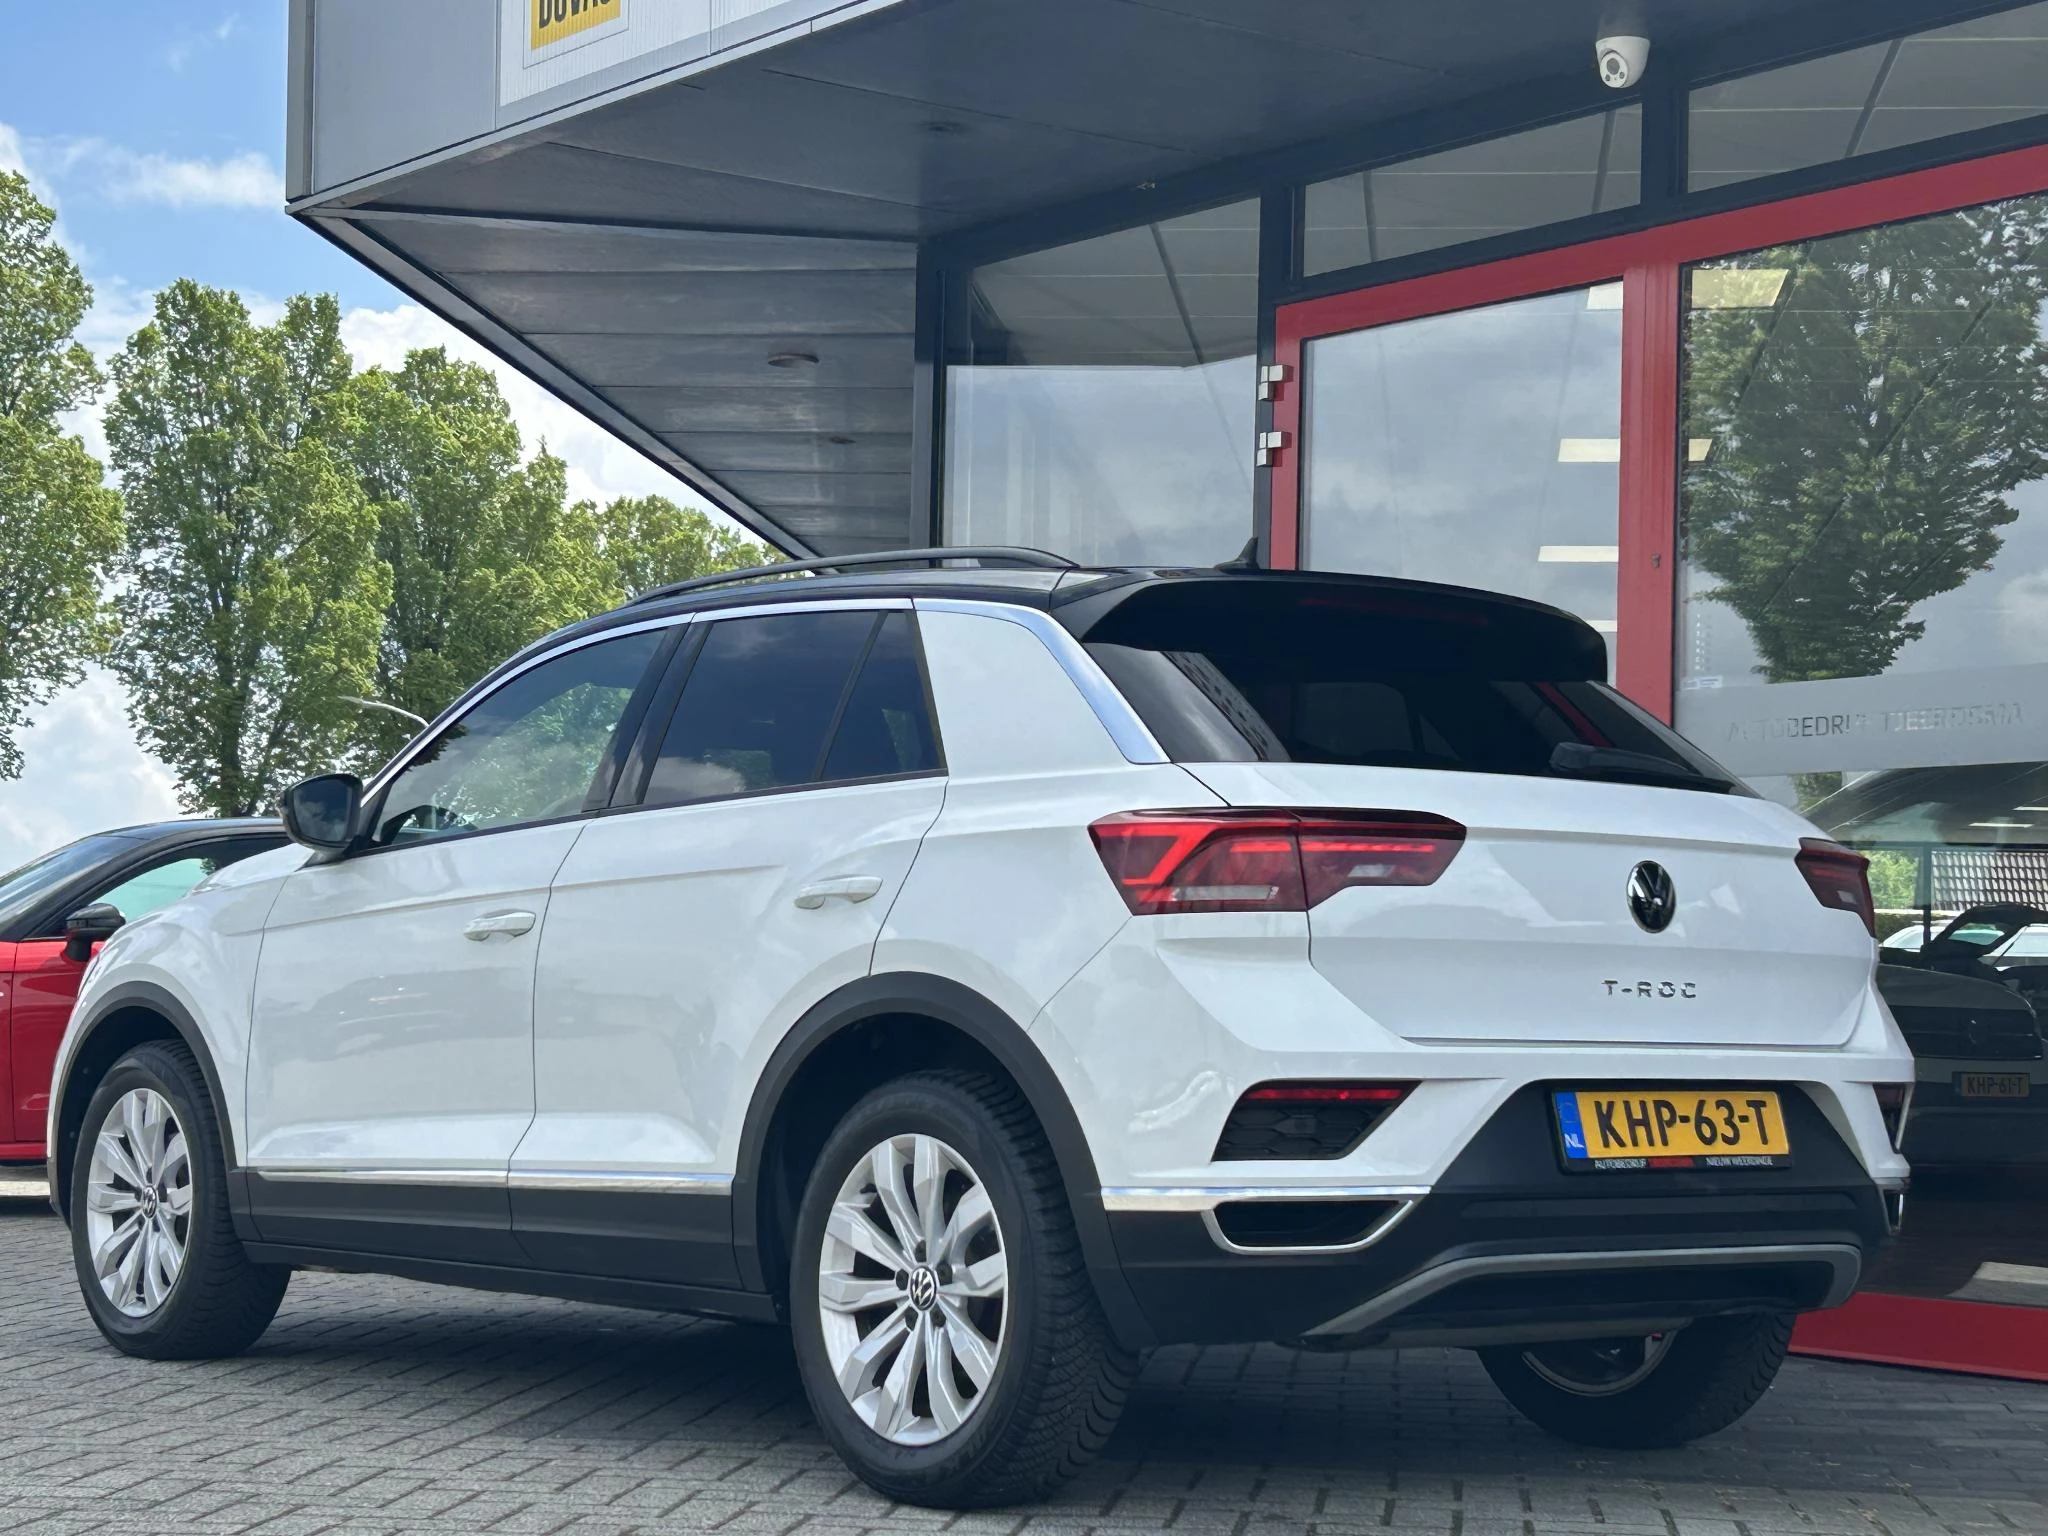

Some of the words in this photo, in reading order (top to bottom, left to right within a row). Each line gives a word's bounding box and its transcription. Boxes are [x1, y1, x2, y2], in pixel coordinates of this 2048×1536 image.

[1602, 980, 1697, 998] T-ROC
[1594, 1100, 1769, 1148] KHP-63-T
[1564, 1133, 1585, 1148] NL
